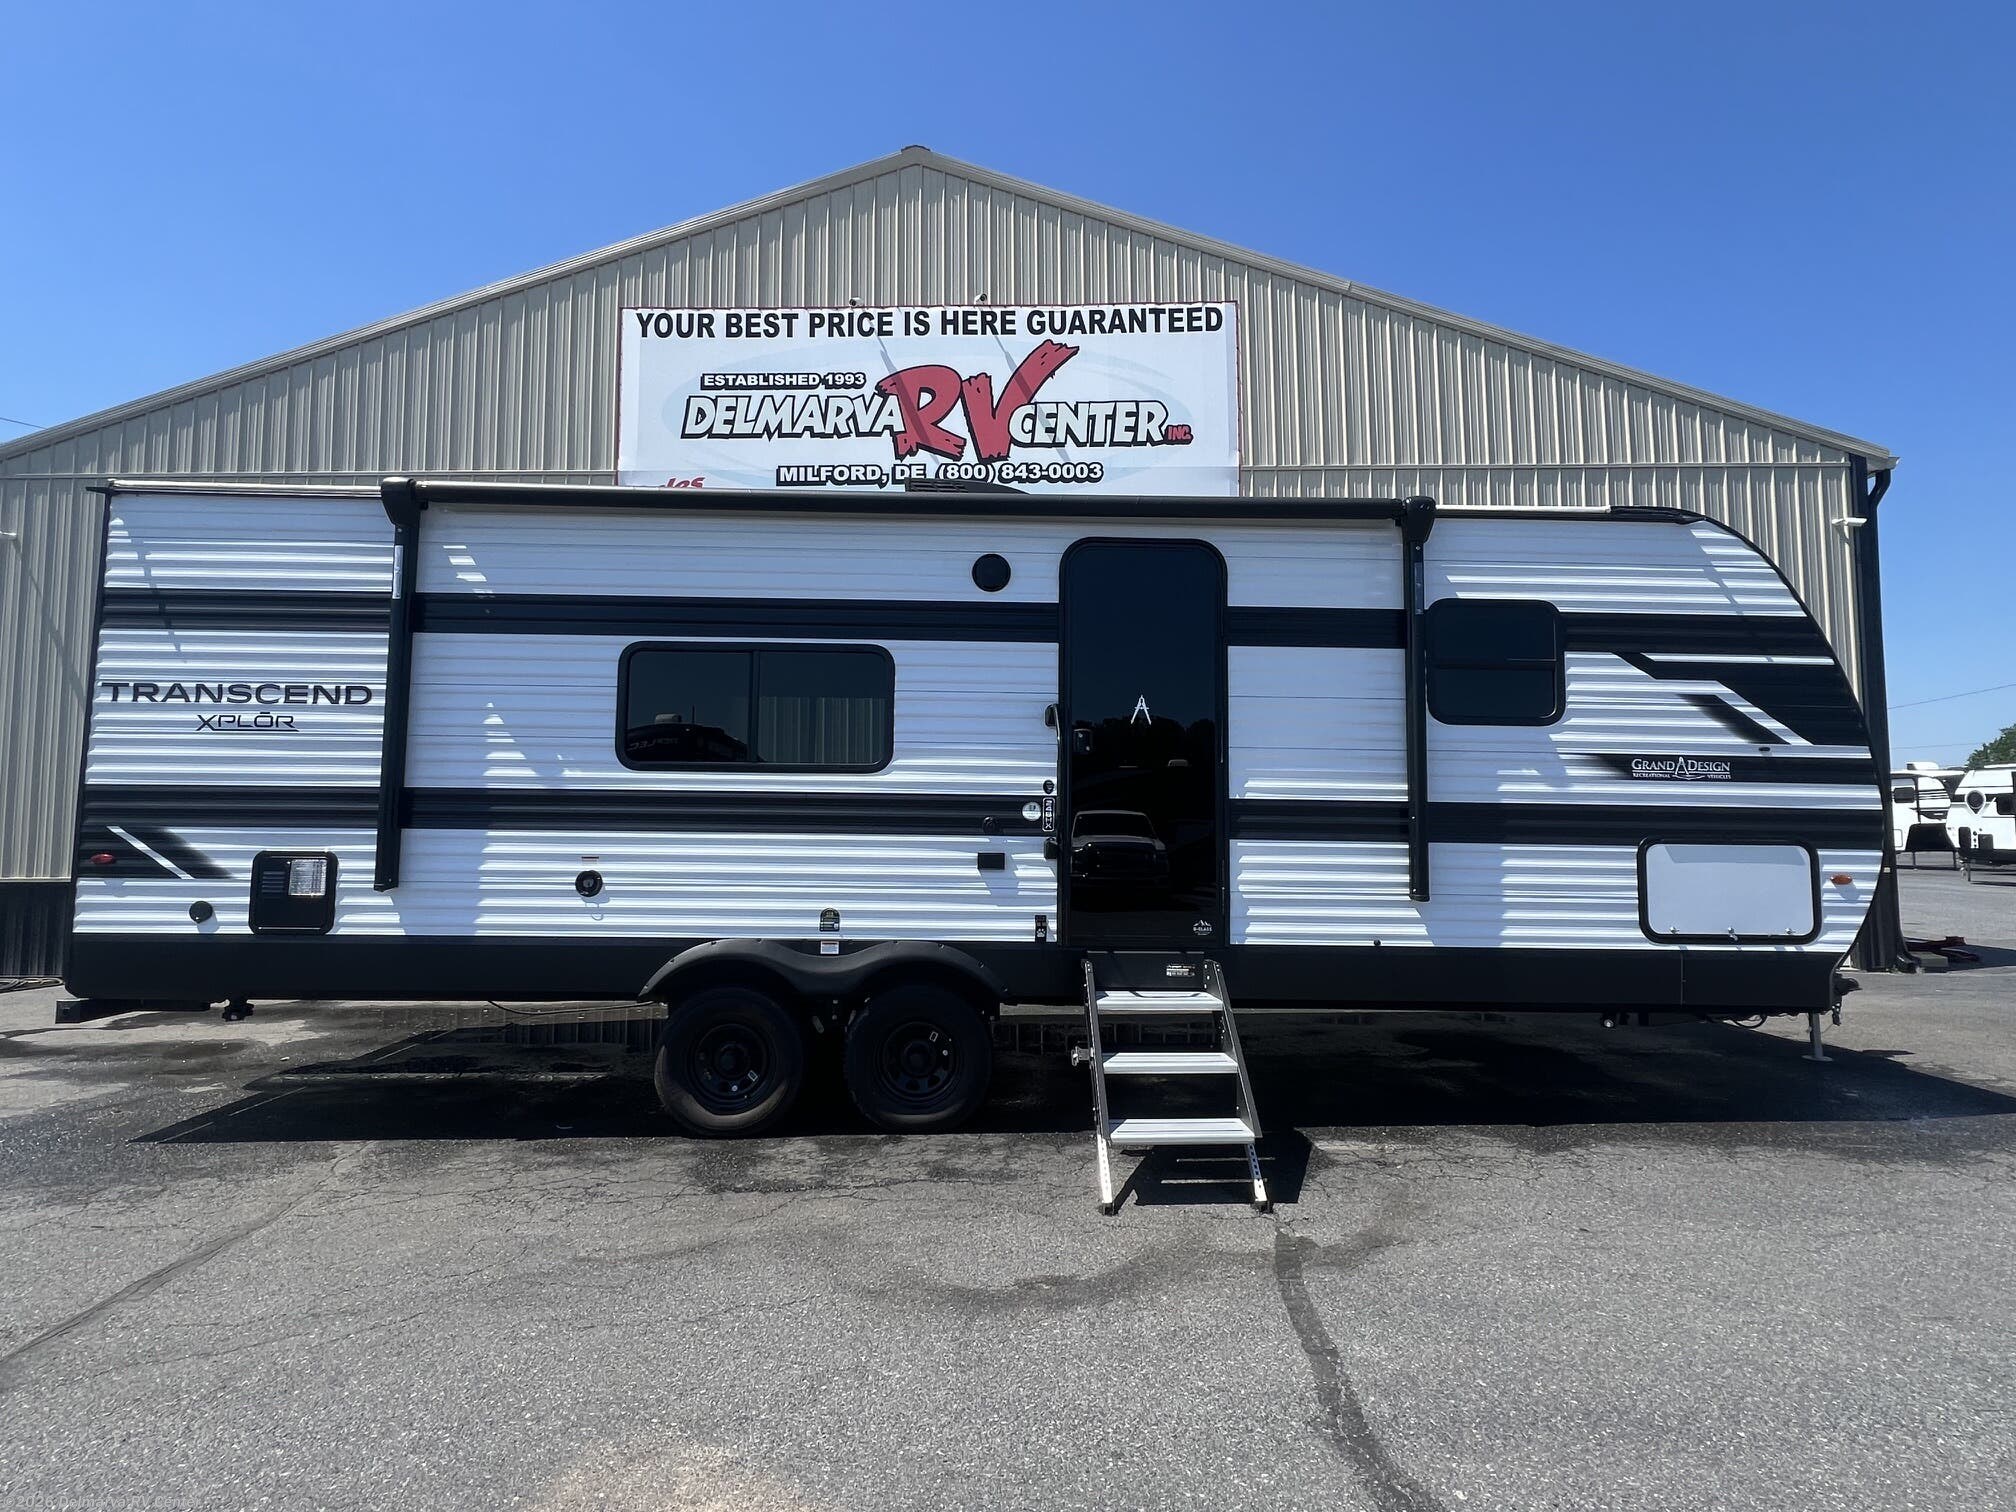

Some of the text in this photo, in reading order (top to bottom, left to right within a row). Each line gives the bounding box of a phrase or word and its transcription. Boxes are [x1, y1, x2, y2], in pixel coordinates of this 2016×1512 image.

[636, 306, 1223, 339] YOUR BEST PRICE IS HERE GUARANTEED
[702, 372, 866, 388] ESTABLISHED 1993
[682, 394, 906, 440] DELMARVA
[876, 339, 1080, 464] RV
[1009, 400, 1169, 447] CENTER
[777, 463, 1103, 485] MILFORD, DE (800) 843-0003
[100, 682, 373, 706] TRANSCEND
[1631, 758, 1731, 772] GRAND DESIGN
